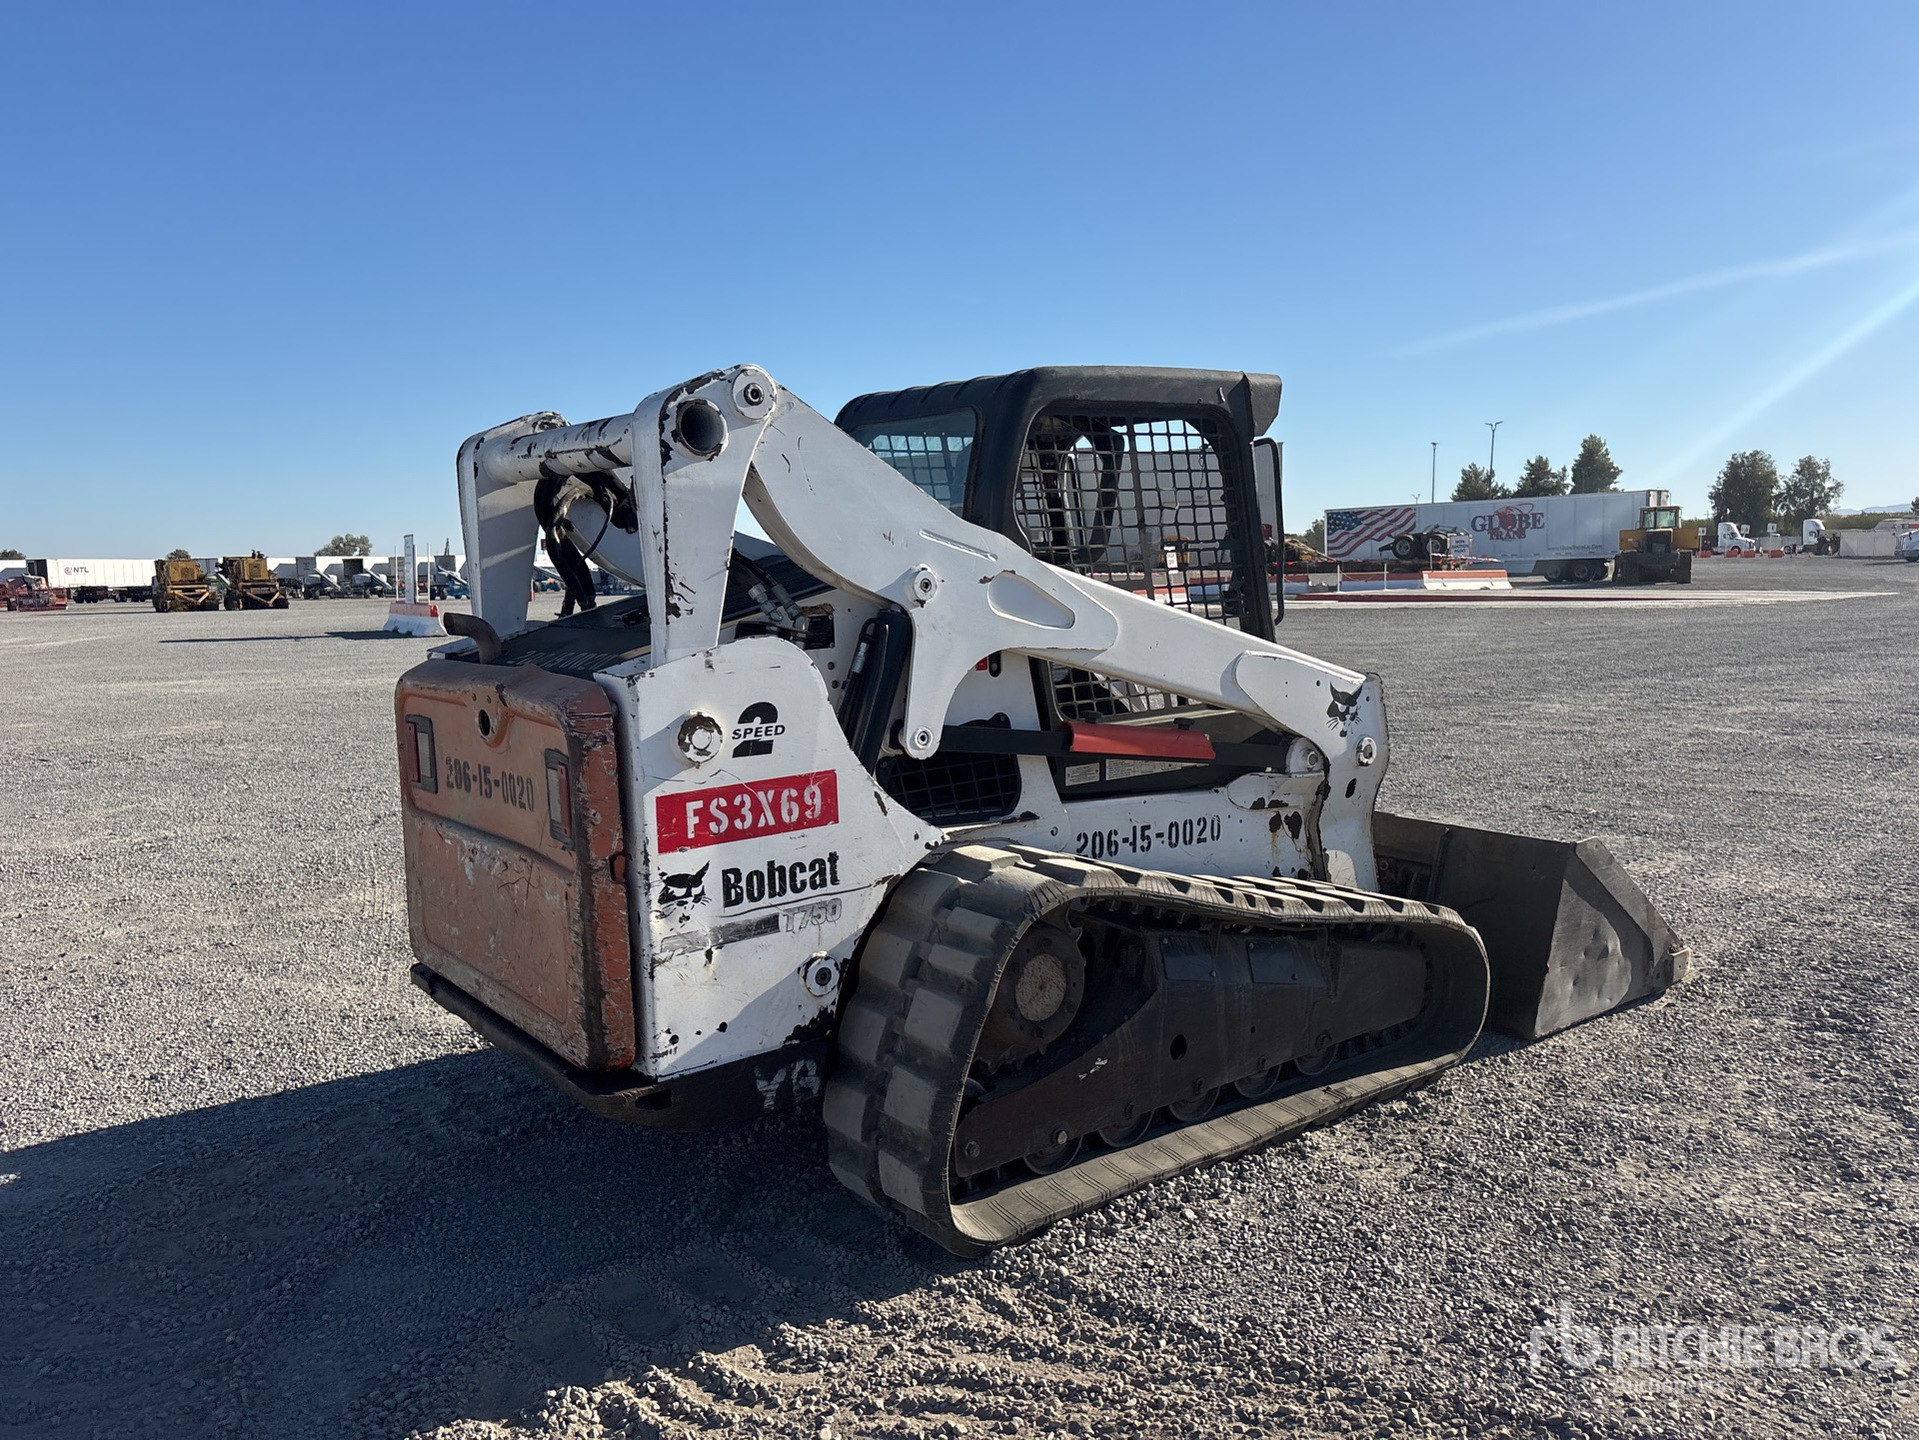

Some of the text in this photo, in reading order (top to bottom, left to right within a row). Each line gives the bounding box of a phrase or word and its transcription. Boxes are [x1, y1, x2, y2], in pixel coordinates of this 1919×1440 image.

[1471, 511, 1545, 532] GLOBE
[1488, 528, 1527, 541] TRANS
[731, 724, 786, 740] SPEED
[732, 701, 778, 758] 2
[445, 755, 535, 812] 206-15-0020
[685, 783, 822, 839] FS3X69
[1076, 814, 1221, 859] 206-15-0020
[721, 851, 840, 909] Bobcat
